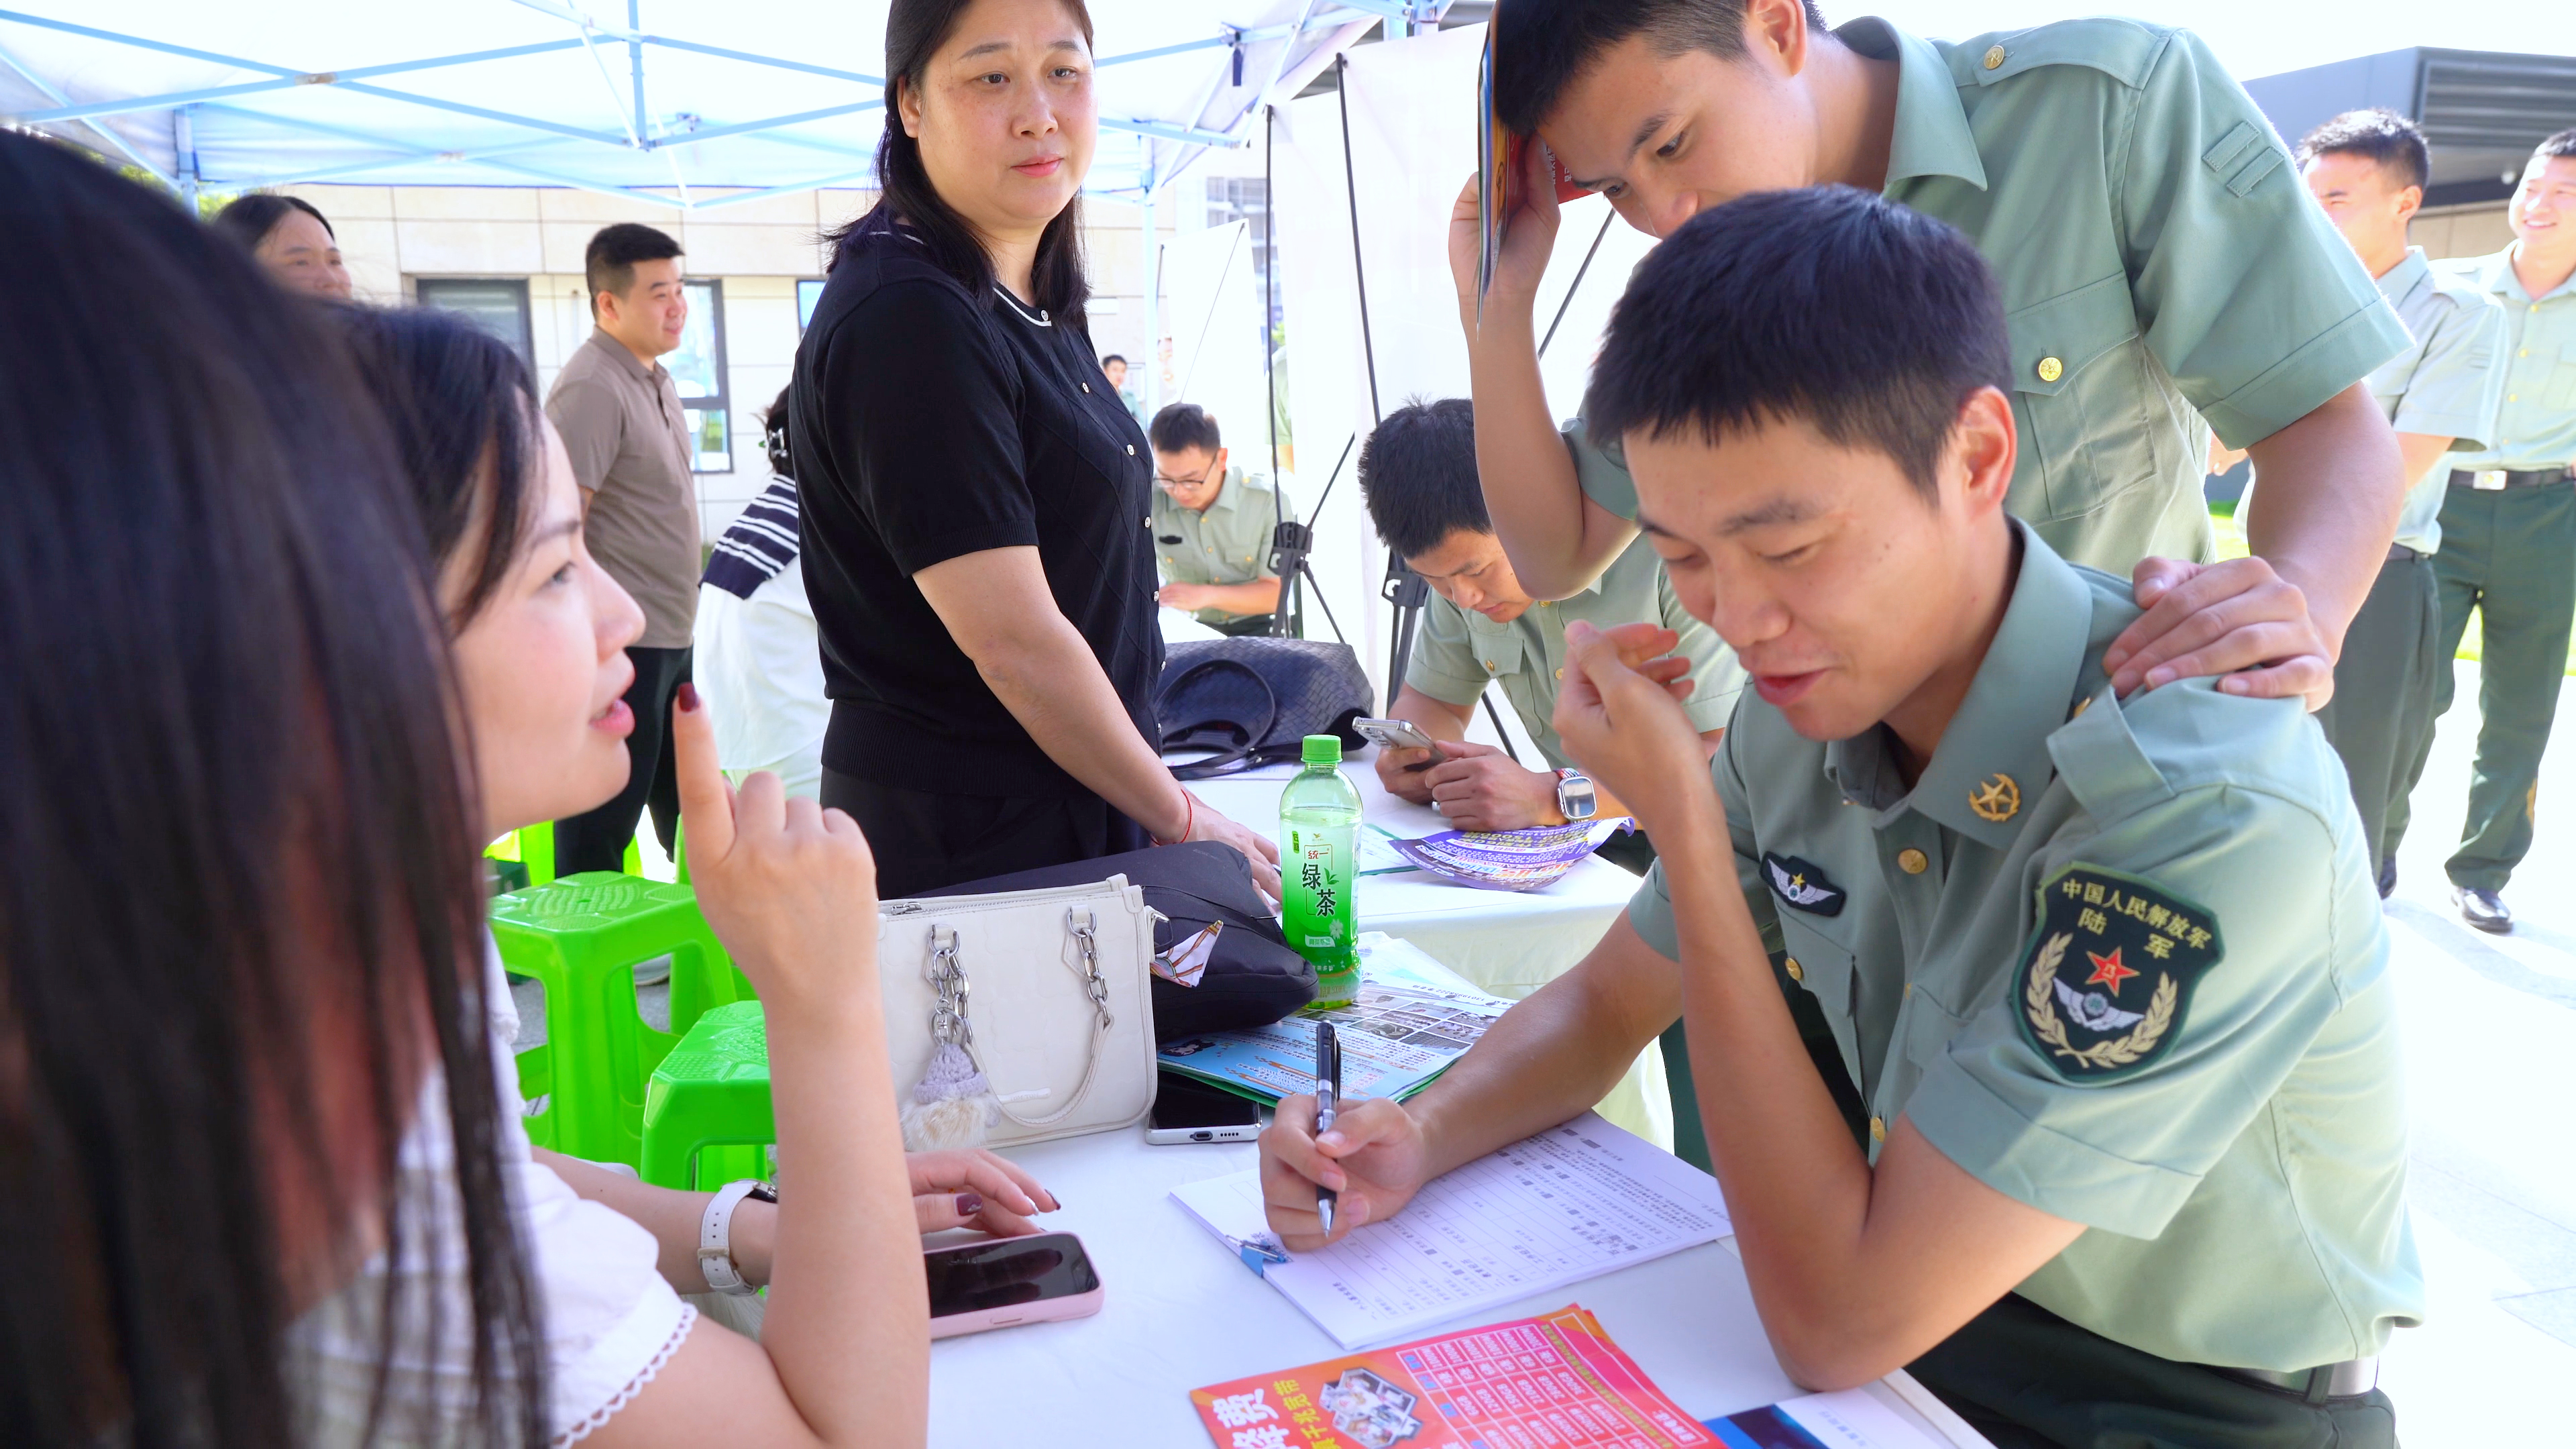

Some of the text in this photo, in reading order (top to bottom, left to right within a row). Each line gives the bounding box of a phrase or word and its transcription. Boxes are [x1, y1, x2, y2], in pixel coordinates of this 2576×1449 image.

[1308, 850, 1328, 859] 统一
[1302, 863, 1336, 917] 绿茶
[2062, 878, 2212, 950] 中国人民解放军
[2077, 908, 2176, 959] 陆 军
